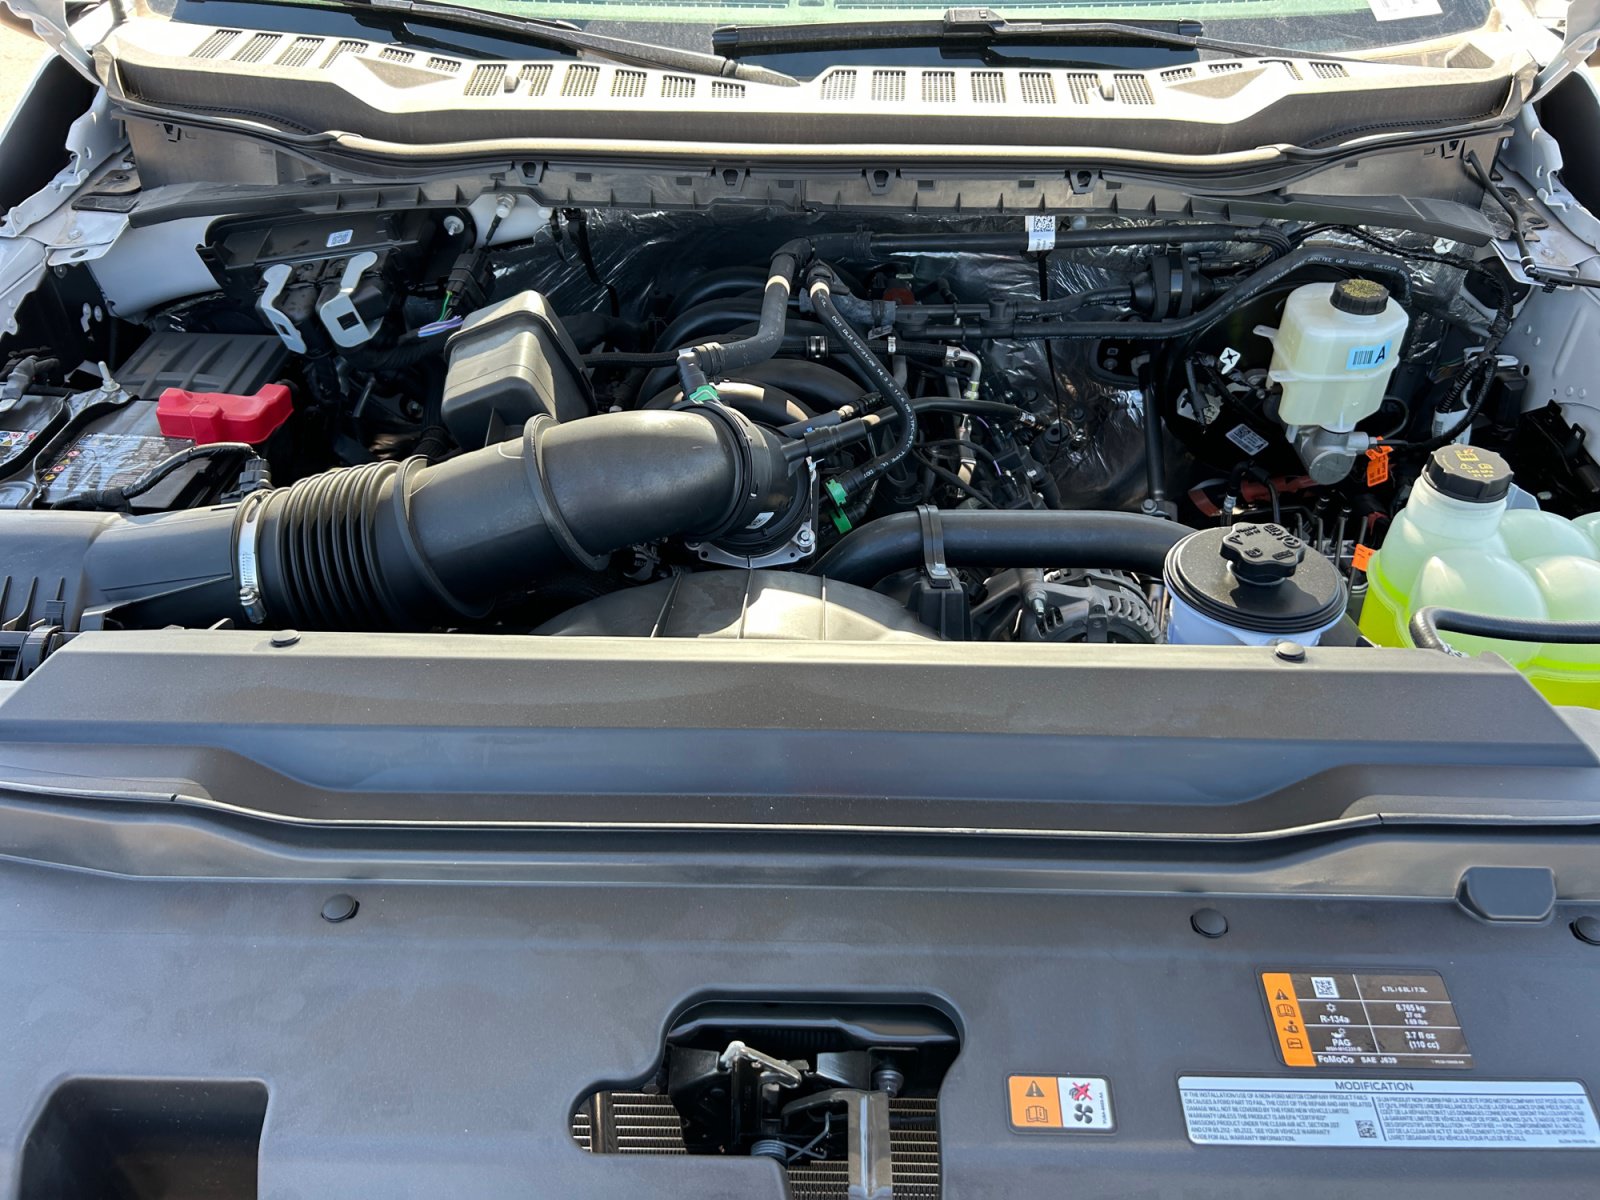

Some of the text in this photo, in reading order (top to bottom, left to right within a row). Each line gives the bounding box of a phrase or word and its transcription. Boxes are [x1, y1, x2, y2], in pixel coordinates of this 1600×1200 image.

[1374, 345, 1386, 364] A
[1415, 1004, 1426, 1013] kg
[1320, 1015, 1350, 1023] R-134a
[1405, 1031, 1417, 1039] 3.7
[1418, 1031, 1425, 1039] fl
[1427, 1041, 1440, 1050] cc)
[1317, 1055, 1354, 1064] FoMoCo
[1335, 1081, 1414, 1090] MODIFICATION
